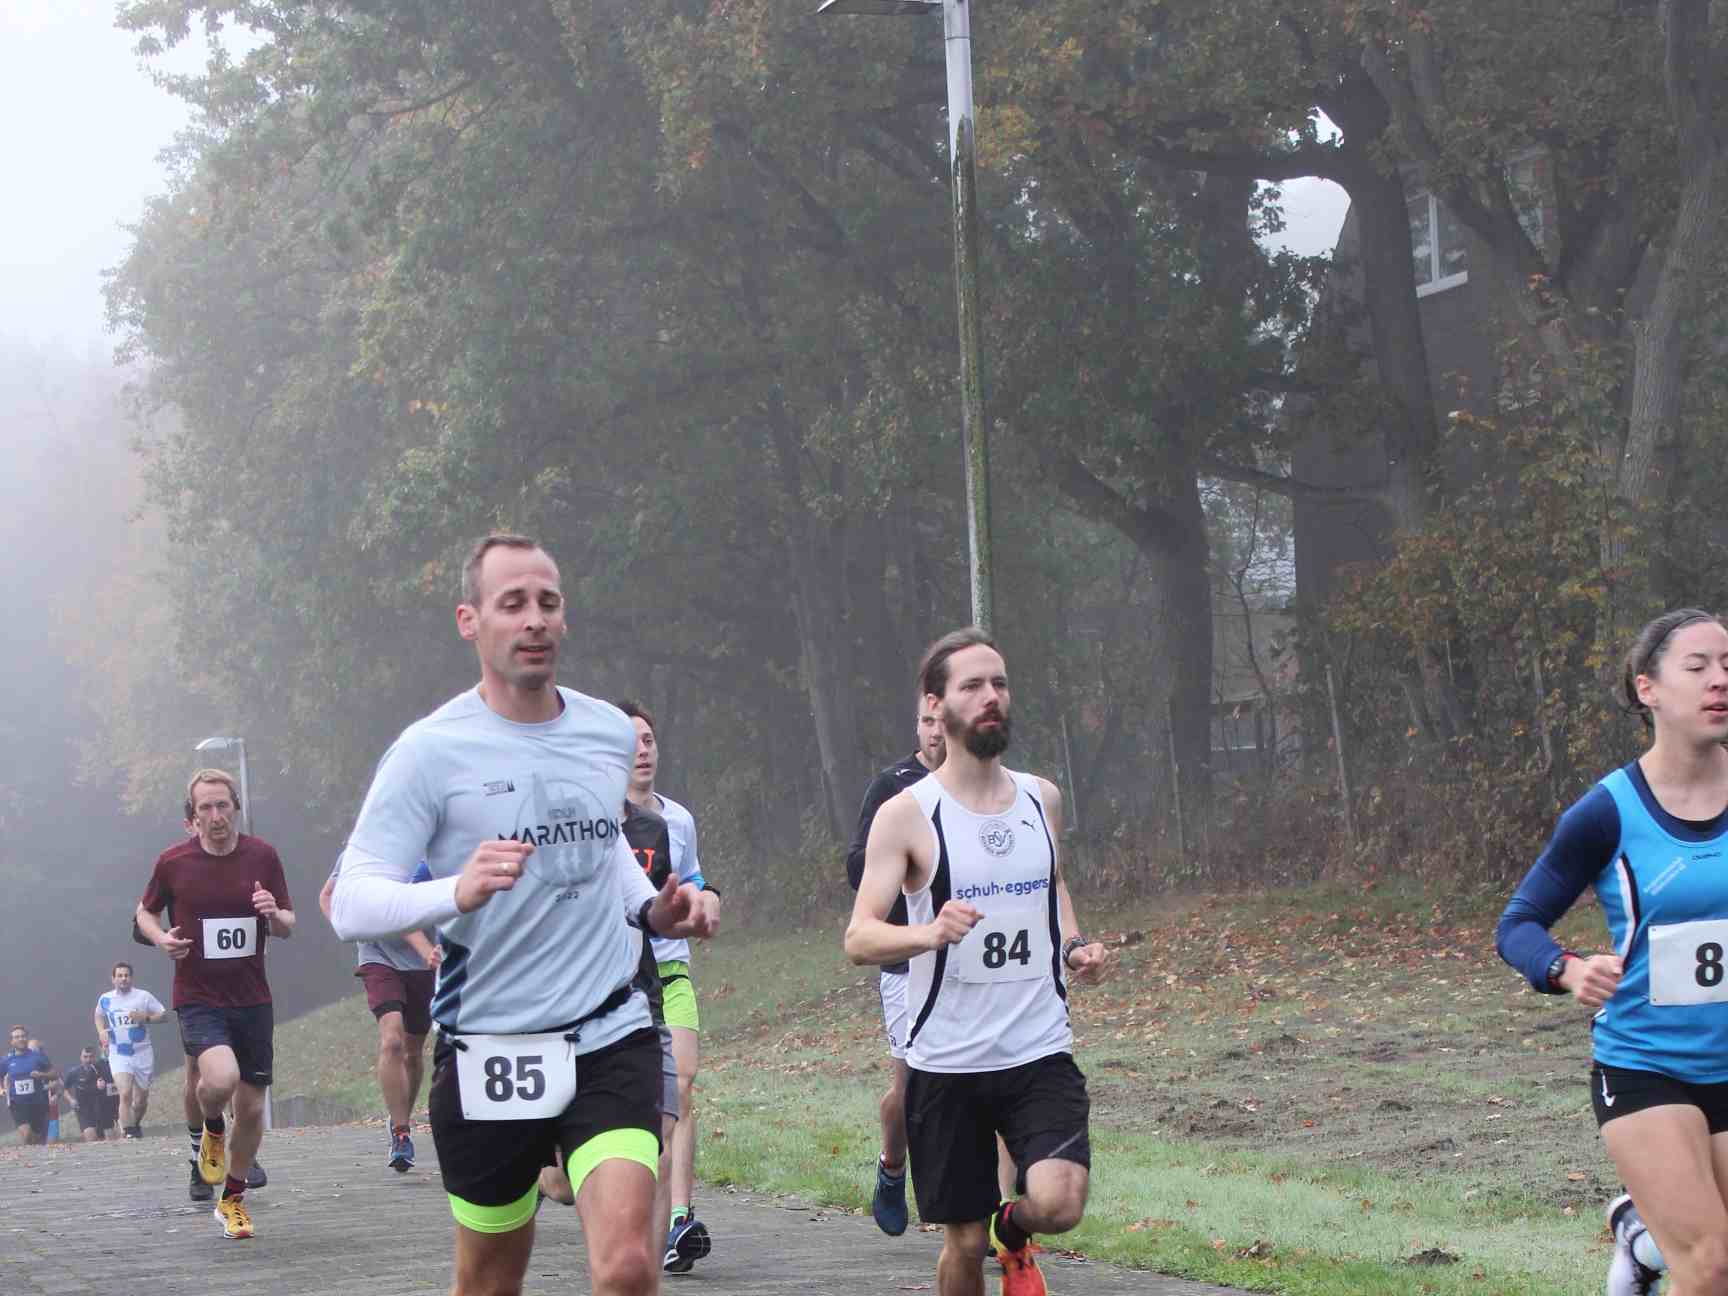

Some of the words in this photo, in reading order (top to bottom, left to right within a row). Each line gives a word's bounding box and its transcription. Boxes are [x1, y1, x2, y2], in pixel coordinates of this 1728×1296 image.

[217, 928, 246, 950] 60
[983, 929, 1031, 969] 84
[1695, 942, 1724, 987] 8
[484, 1055, 546, 1102] 85
